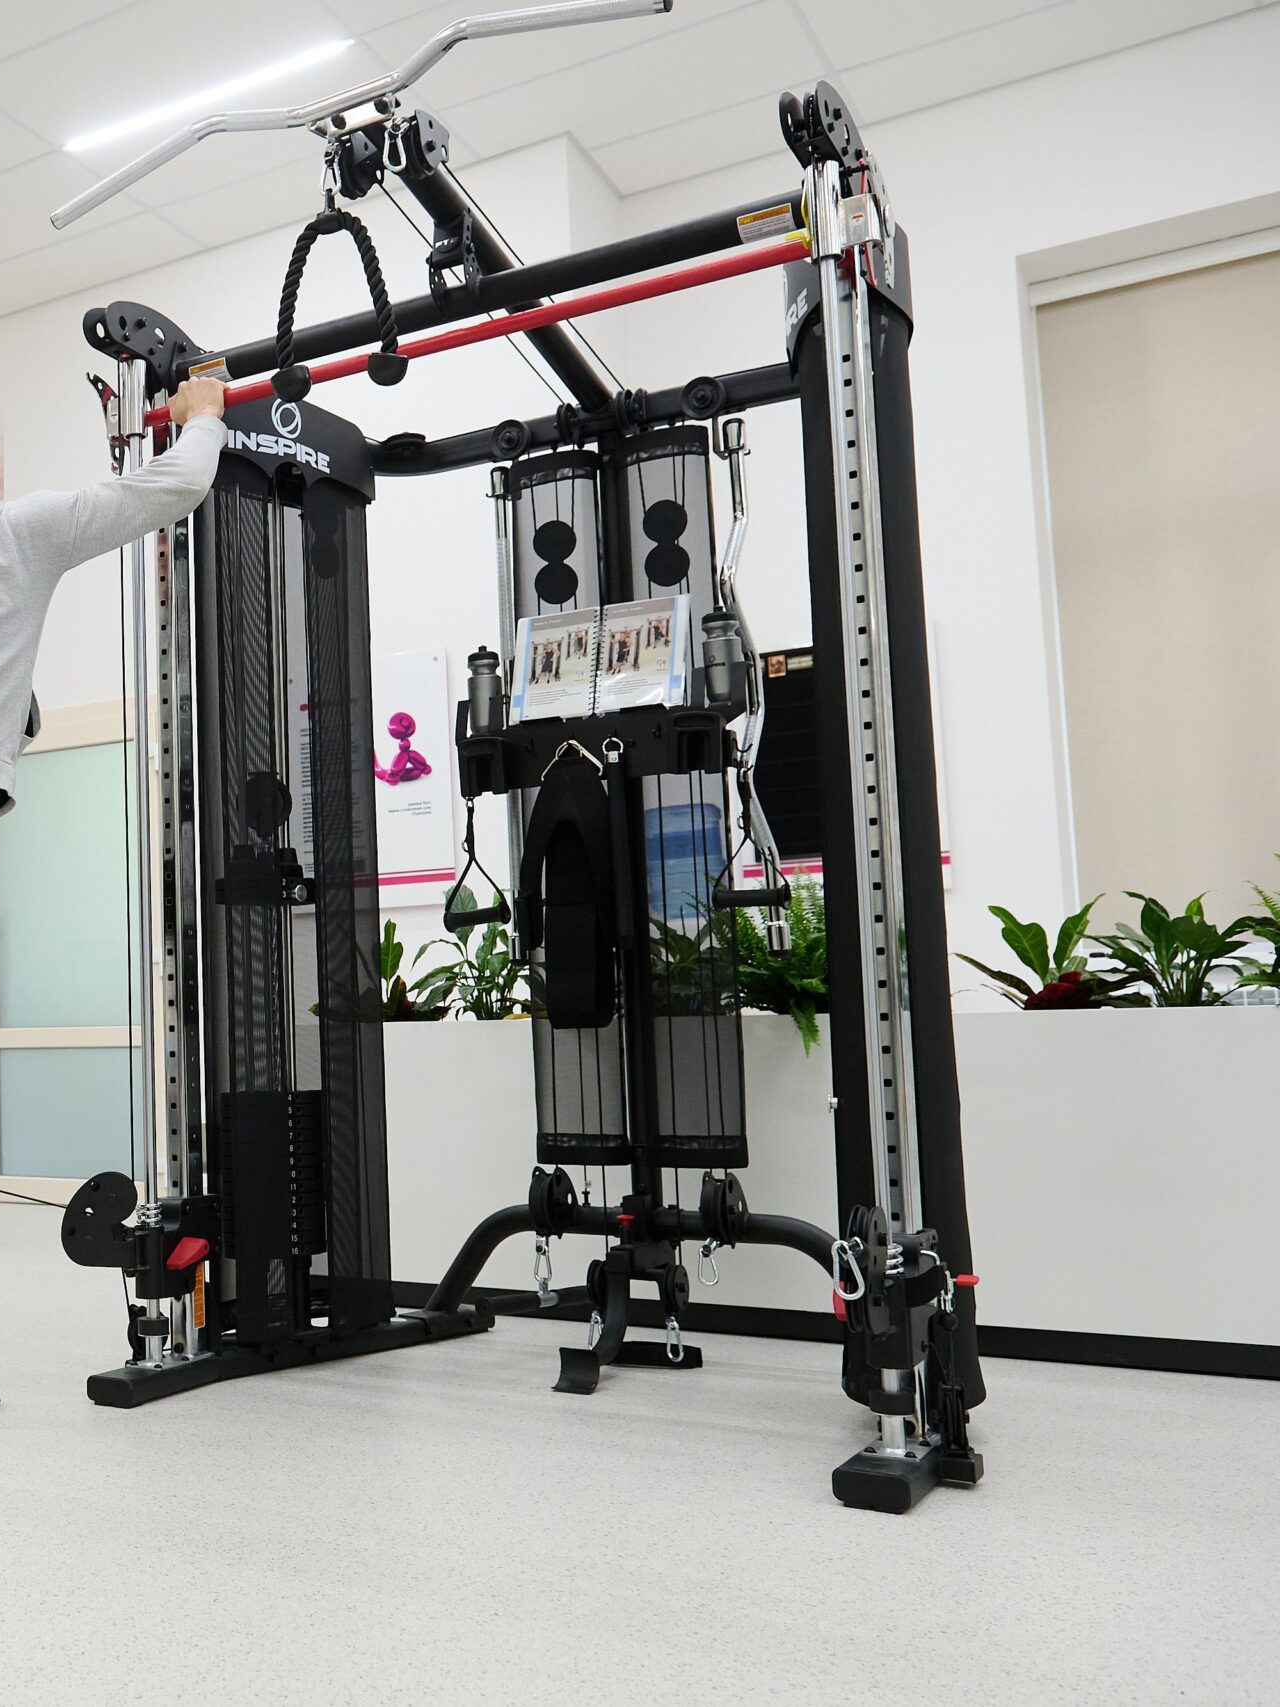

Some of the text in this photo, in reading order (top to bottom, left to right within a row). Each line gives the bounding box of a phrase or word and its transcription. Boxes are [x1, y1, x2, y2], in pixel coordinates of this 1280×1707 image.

[227, 429, 331, 474] INSPIRE
[291, 1234, 298, 1242] 15
[291, 1247, 299, 1255] 16
